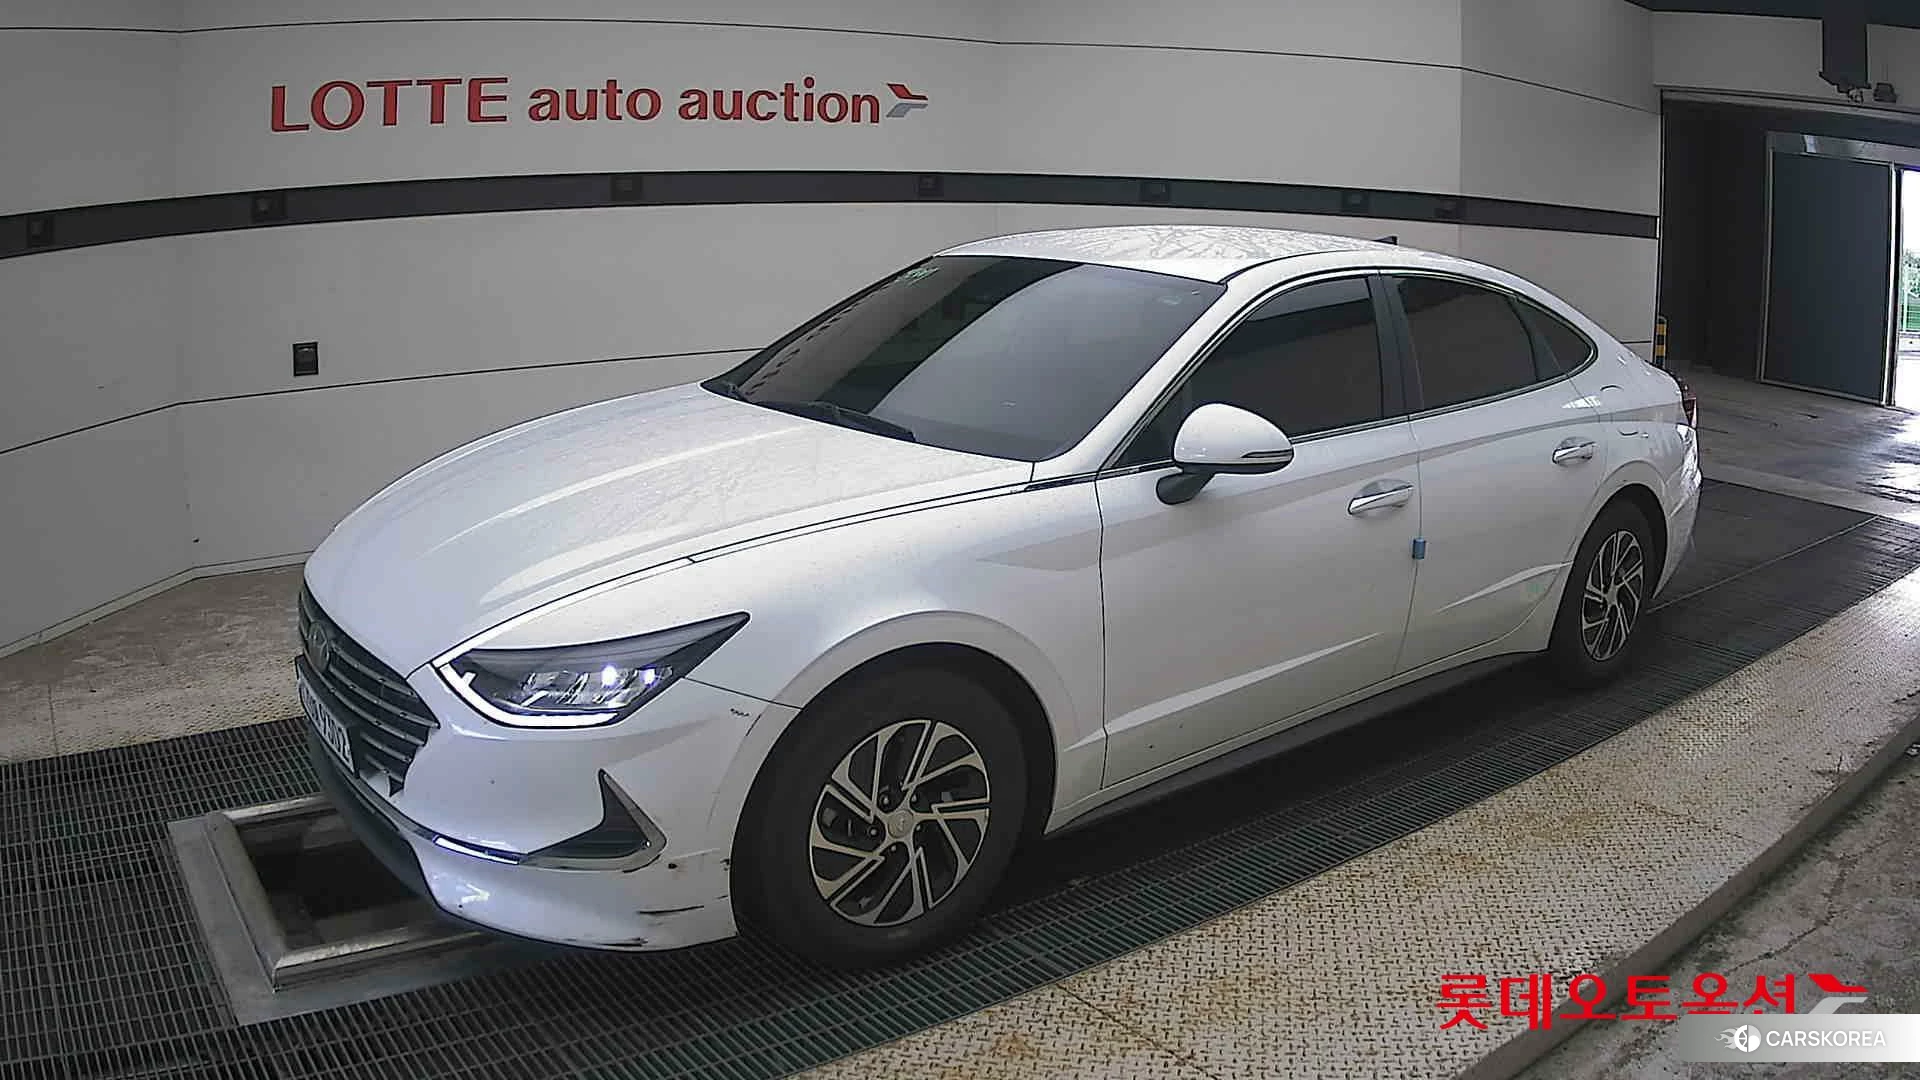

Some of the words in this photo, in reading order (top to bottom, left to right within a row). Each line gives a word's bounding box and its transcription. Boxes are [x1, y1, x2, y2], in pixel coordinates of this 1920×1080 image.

[271, 77, 508, 132] LOTTE
[528, 79, 662, 122] auto
[678, 76, 880, 124] auction
